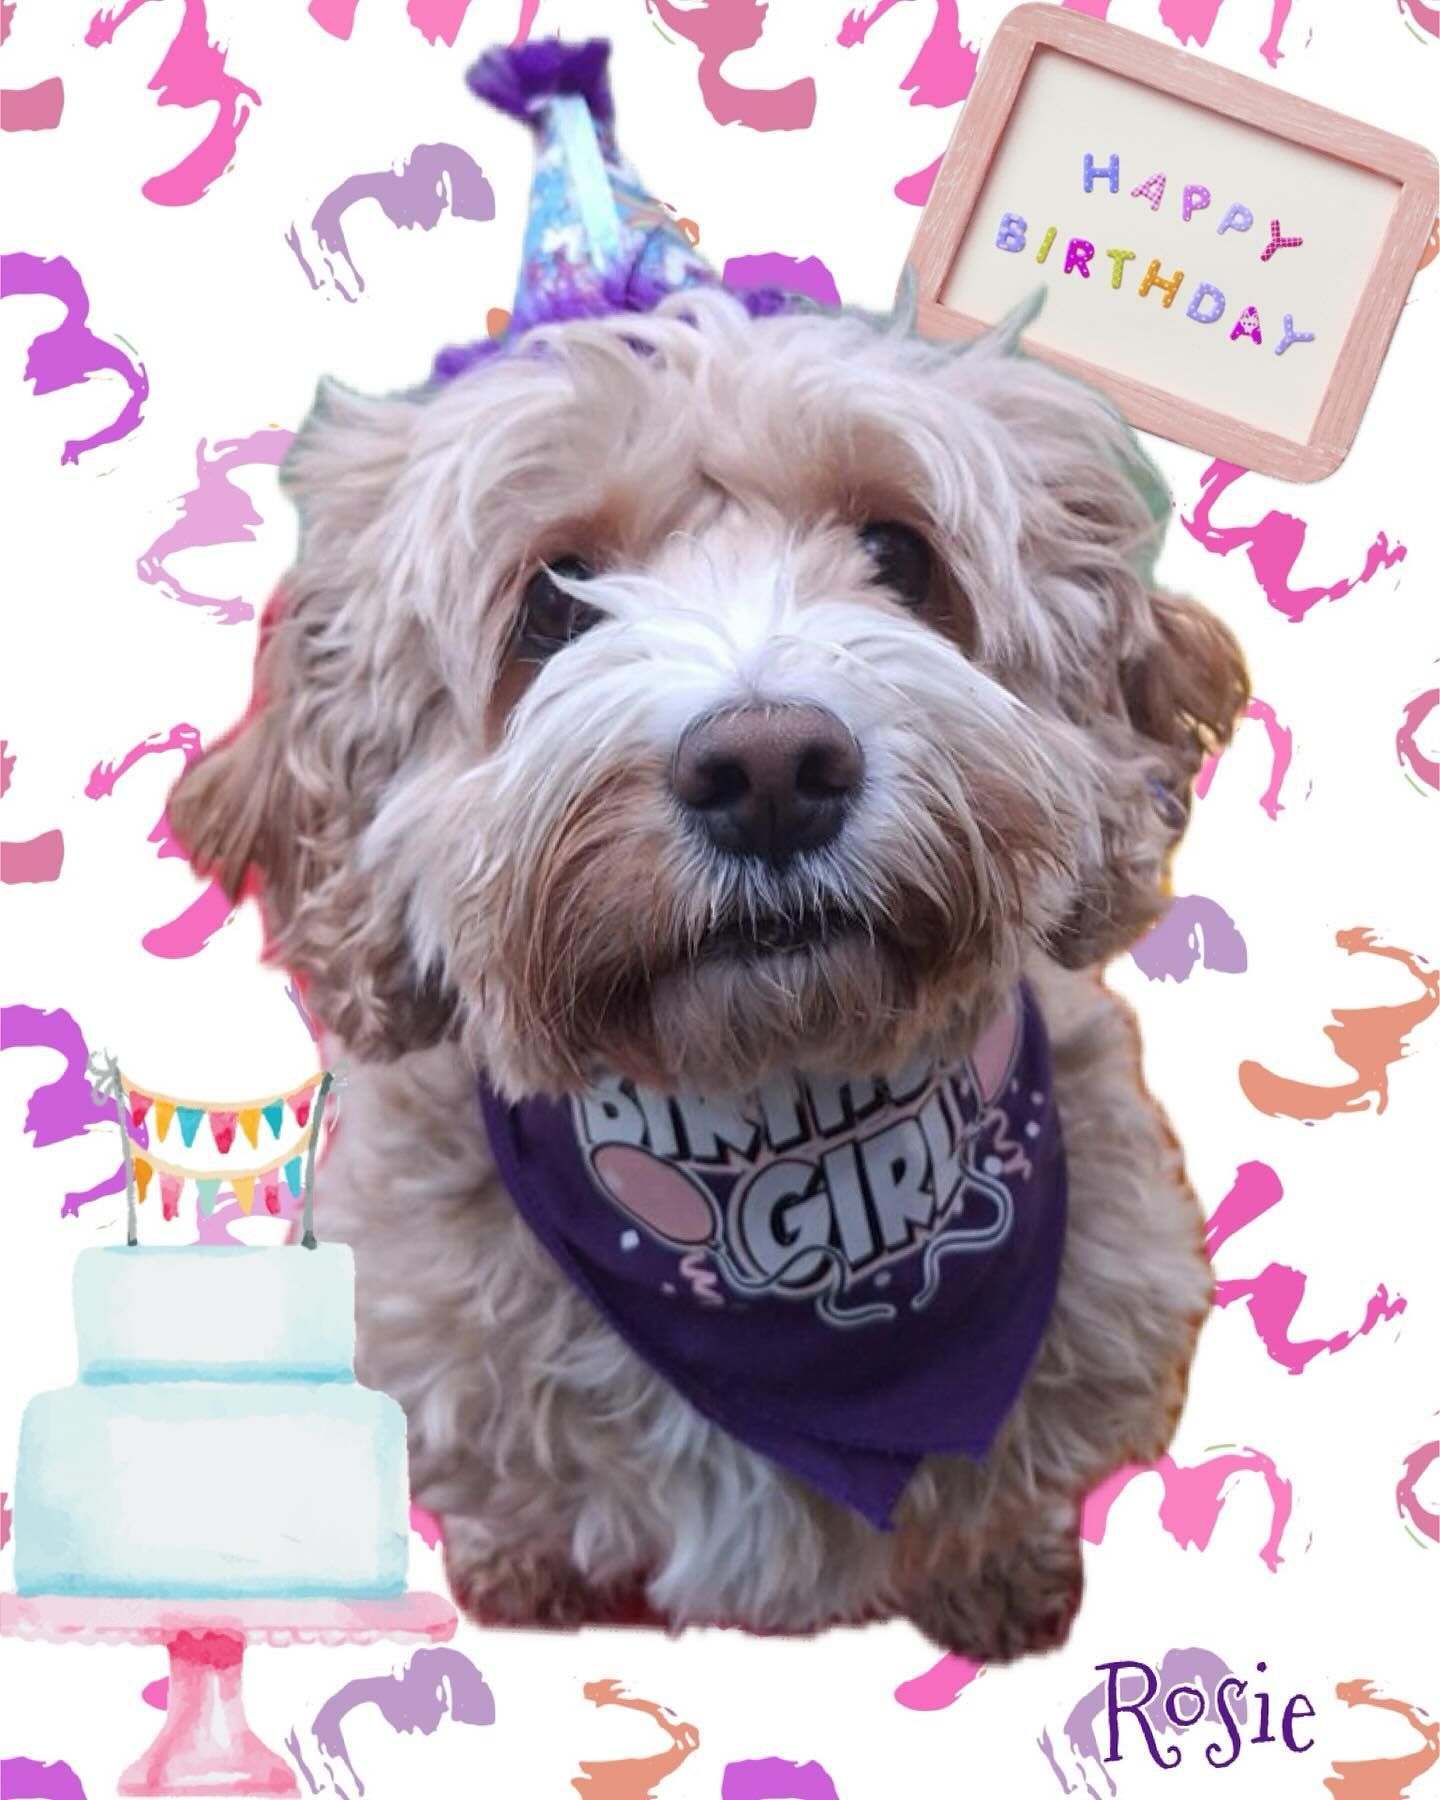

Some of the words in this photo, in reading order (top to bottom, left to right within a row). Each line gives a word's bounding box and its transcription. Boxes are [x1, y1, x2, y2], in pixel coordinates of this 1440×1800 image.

[1082, 152, 1304, 262] HAPPY
[995, 211, 1315, 356] BIRTHDAY
[739, 1093, 962, 1286] GIRL
